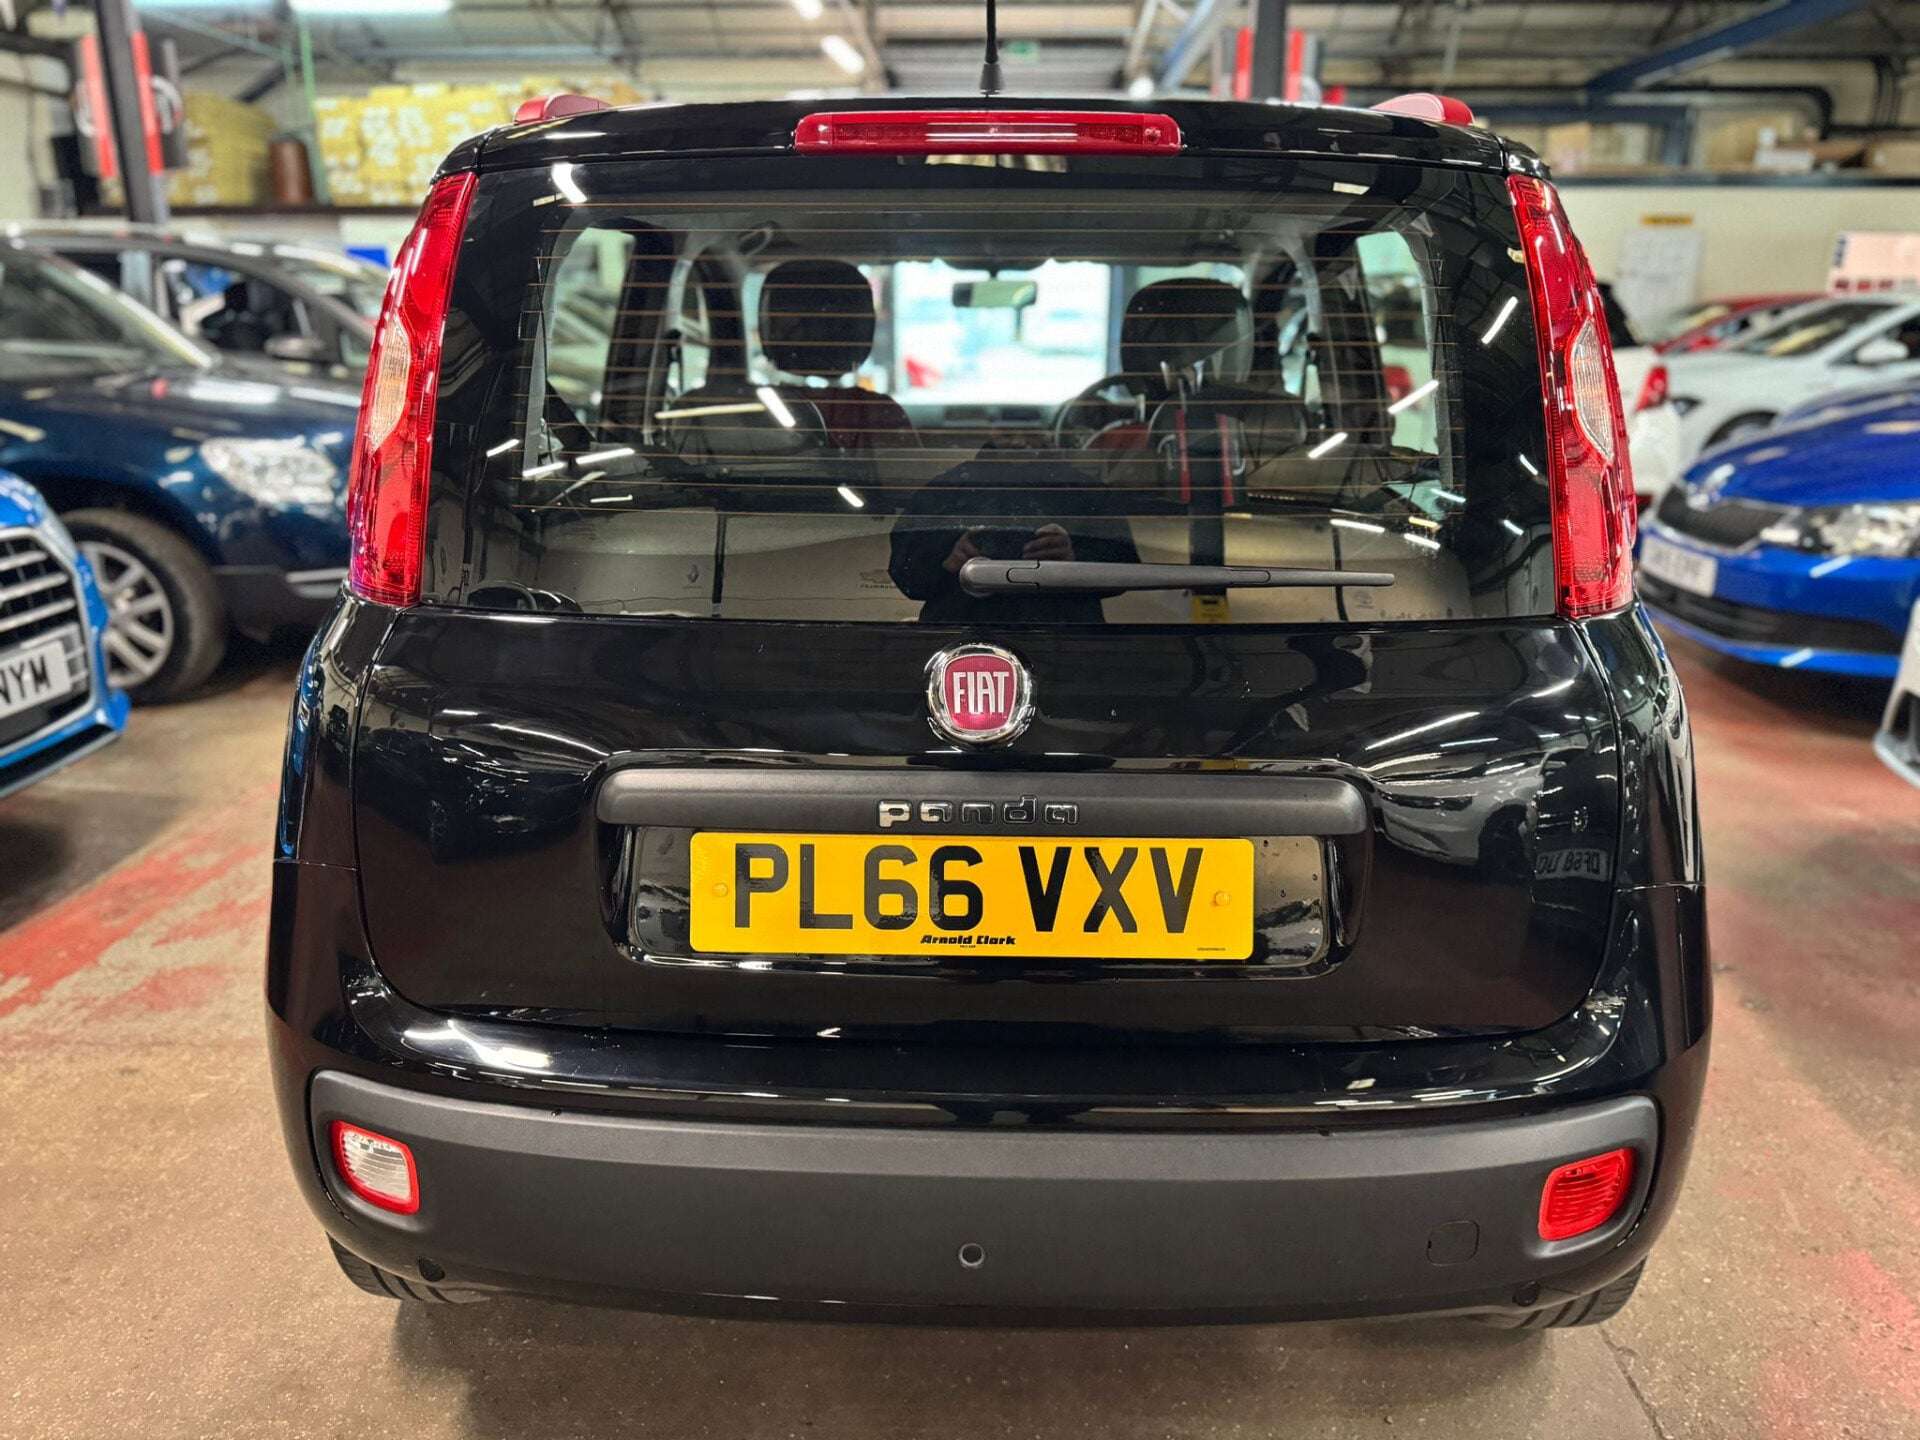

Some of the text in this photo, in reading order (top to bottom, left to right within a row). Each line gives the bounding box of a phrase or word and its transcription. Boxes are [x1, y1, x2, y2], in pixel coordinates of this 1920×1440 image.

[952, 671, 1009, 716] FIAT
[879, 795, 1079, 828] panda
[735, 843, 1204, 934] PL66 VXV
[920, 935, 1015, 945] Arnold Clark
